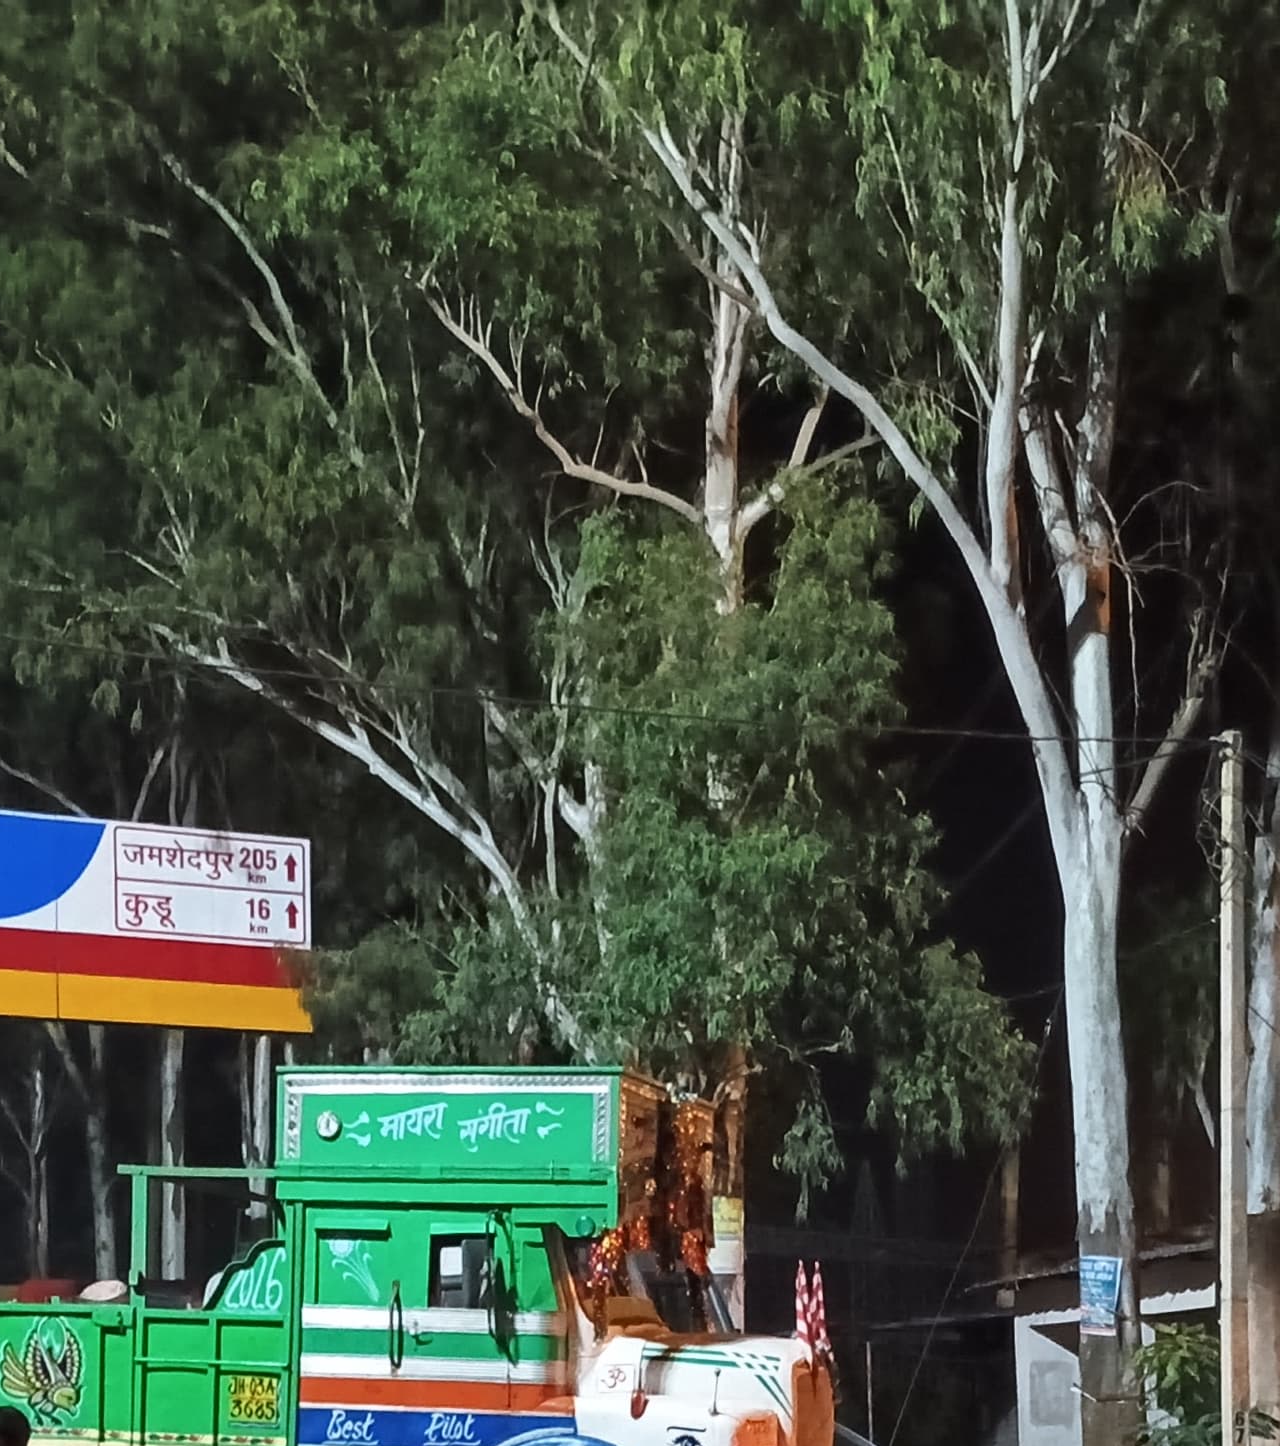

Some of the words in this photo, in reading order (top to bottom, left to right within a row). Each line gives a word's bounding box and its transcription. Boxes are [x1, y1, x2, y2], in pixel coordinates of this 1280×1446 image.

[121, 839, 234, 880] जमशेदपुर
[240, 847, 277, 870] 205
[248, 872, 267, 884] km
[246, 898, 271, 920] 16
[249, 922, 269, 934] km
[326, 1409, 375, 1441] Best
[424, 1412, 476, 1442] Pilot
